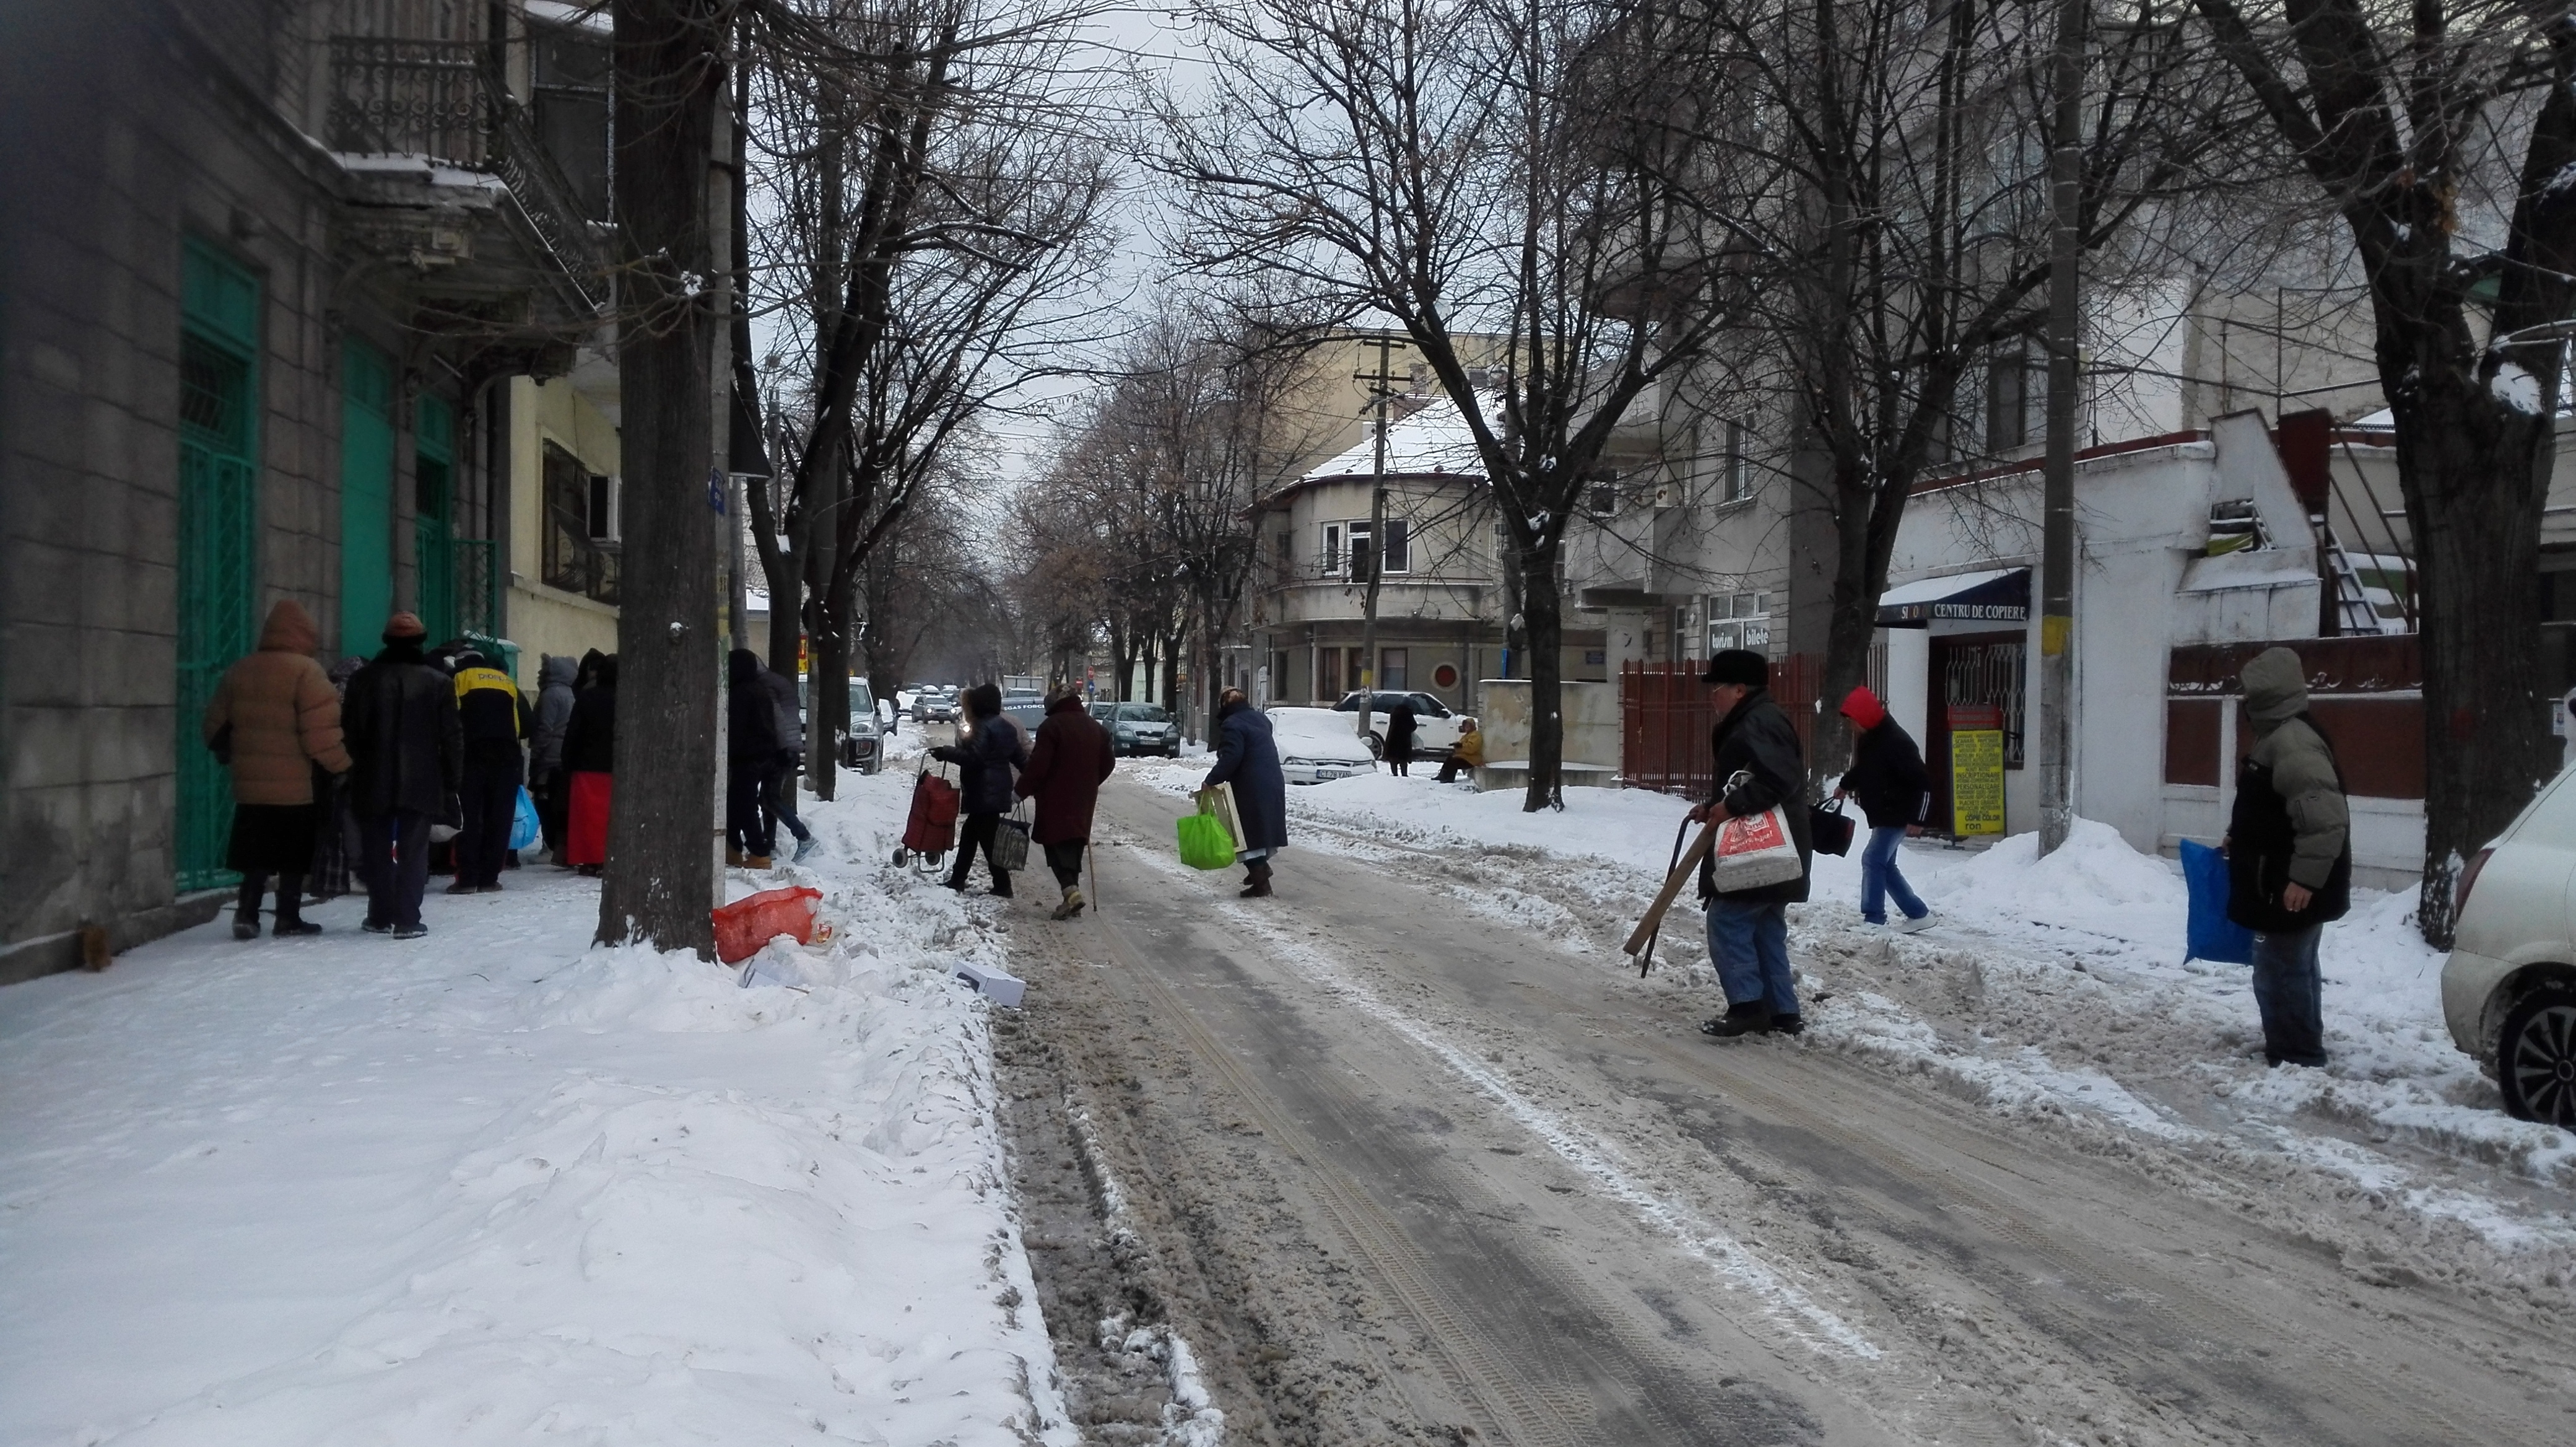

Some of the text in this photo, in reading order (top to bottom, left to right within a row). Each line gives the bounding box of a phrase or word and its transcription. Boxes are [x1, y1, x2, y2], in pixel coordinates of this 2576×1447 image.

[1934, 604, 2026, 619] CENTRU DE COPIERE
[1712, 628, 1769, 649] turism bilete
